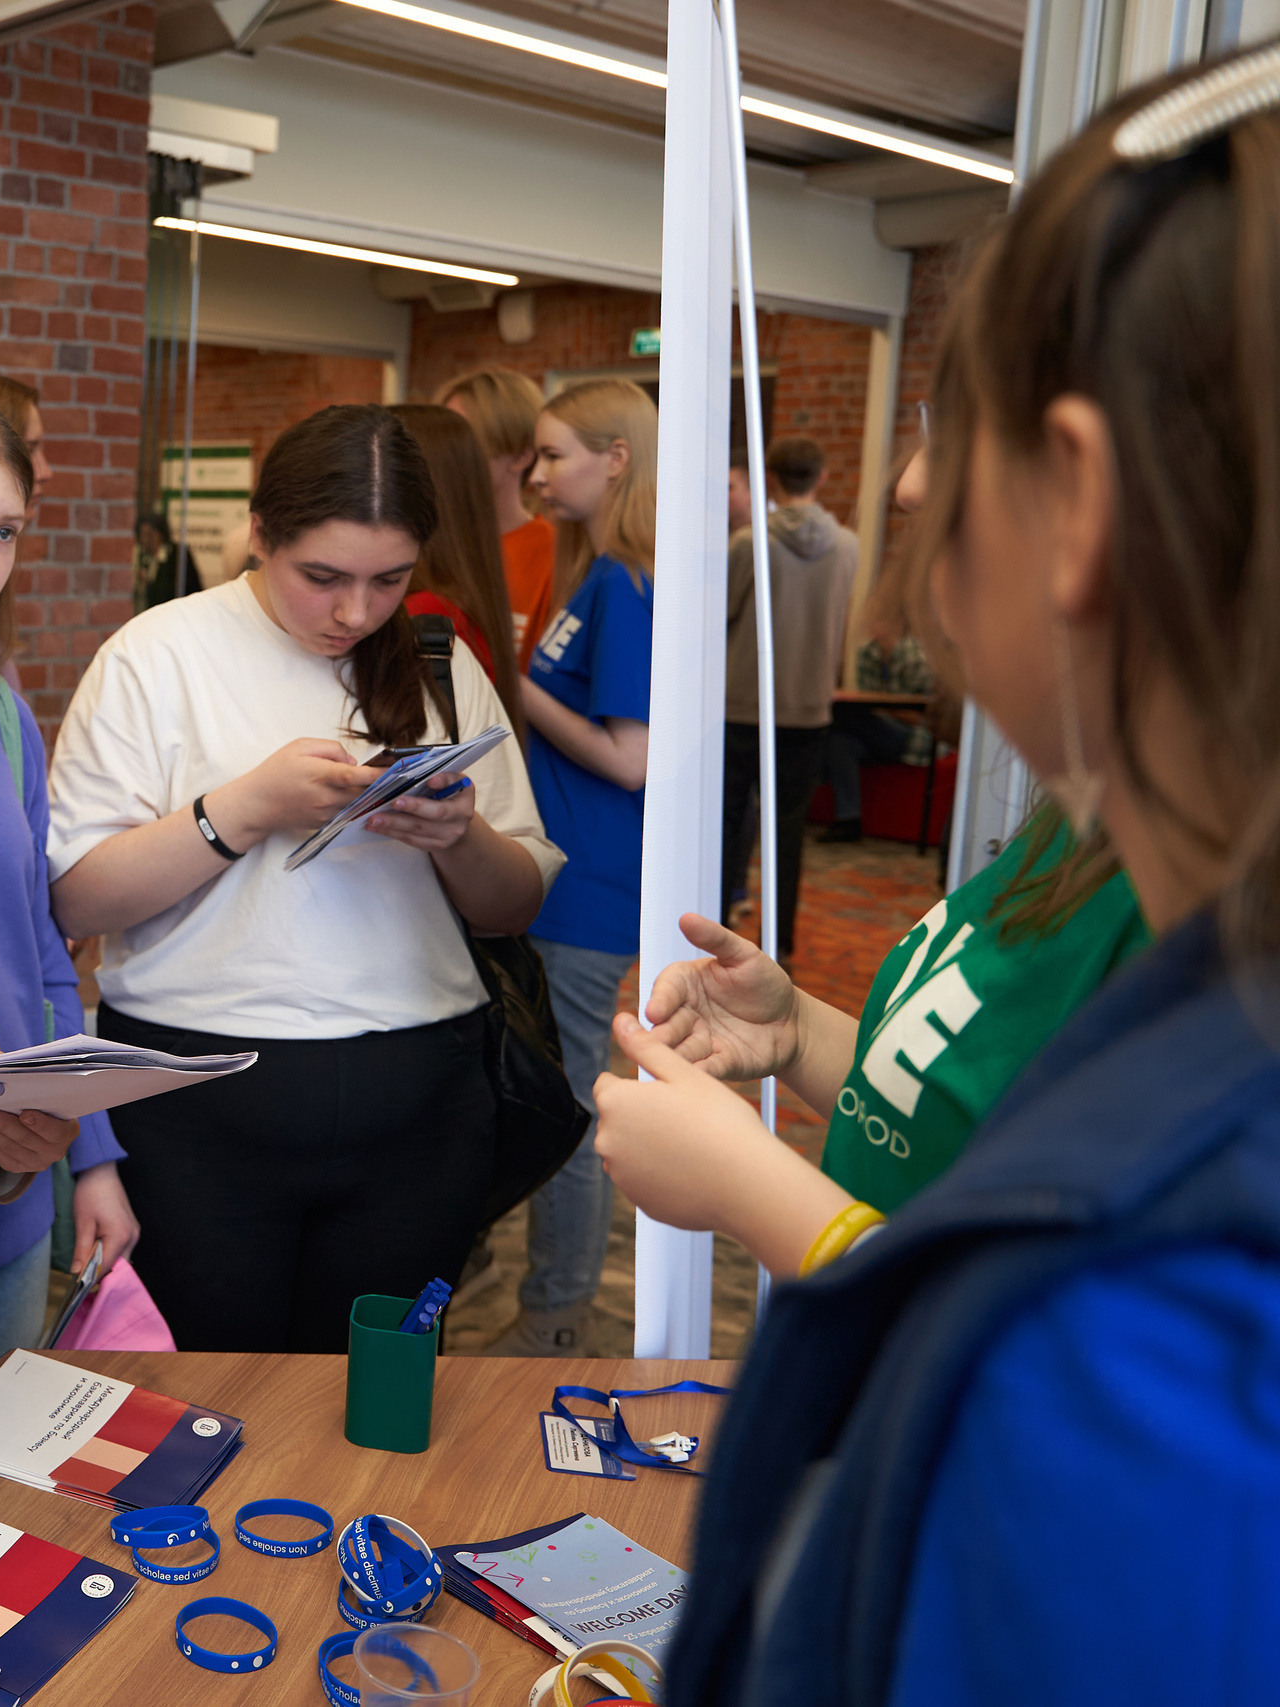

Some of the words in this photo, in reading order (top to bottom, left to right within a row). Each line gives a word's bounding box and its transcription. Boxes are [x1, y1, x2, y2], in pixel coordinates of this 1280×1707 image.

[49, 1383, 82, 1419] экономике
[63, 1381, 102, 1422] бакалавриат
[62, 1385, 115, 1440] Международный
[54, 1422, 65, 1431] по
[27, 1430, 58, 1452] бизнесу
[238, 1533, 251, 1545] sed
[252, 1539, 287, 1554] scholae
[288, 1545, 308, 1555] Non
[139, 1564, 171, 1581] scholae
[173, 1570, 191, 1582] sed
[191, 1566, 210, 1580] vitae
[356, 1534, 368, 1559] vitae
[363, 1561, 383, 1600] discimus
[569, 1602, 661, 1634] WELCOME
[654, 1583, 688, 1610] DAY
[623, 1632, 638, 1641] 23
